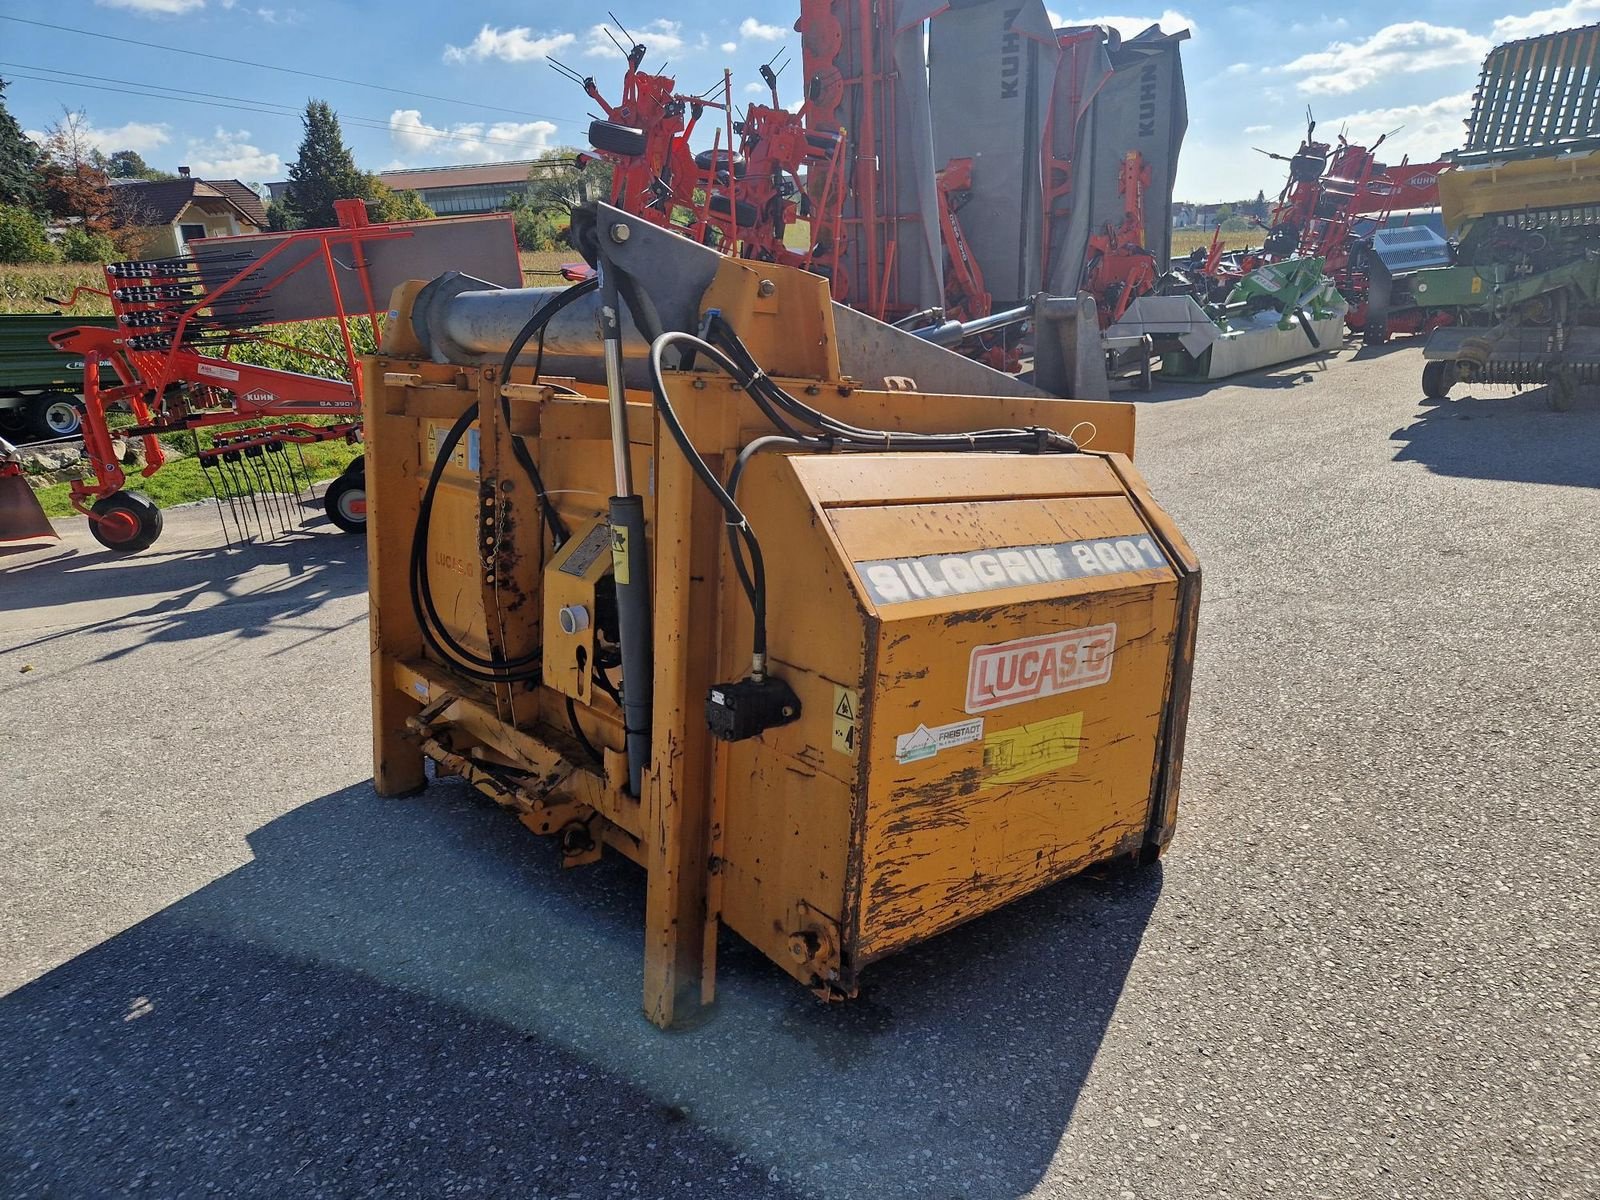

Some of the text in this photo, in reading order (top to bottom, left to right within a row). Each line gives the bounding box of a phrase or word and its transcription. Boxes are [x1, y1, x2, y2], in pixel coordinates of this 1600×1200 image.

[1000, 8, 1021, 99] KUHN
[1138, 63, 1157, 137] KUHN
[1410, 176, 1436, 185] KUHN
[246, 393, 274, 401] KUHN
[1071, 538, 1162, 572] 2001
[938, 724, 981, 741] FREISTADT
